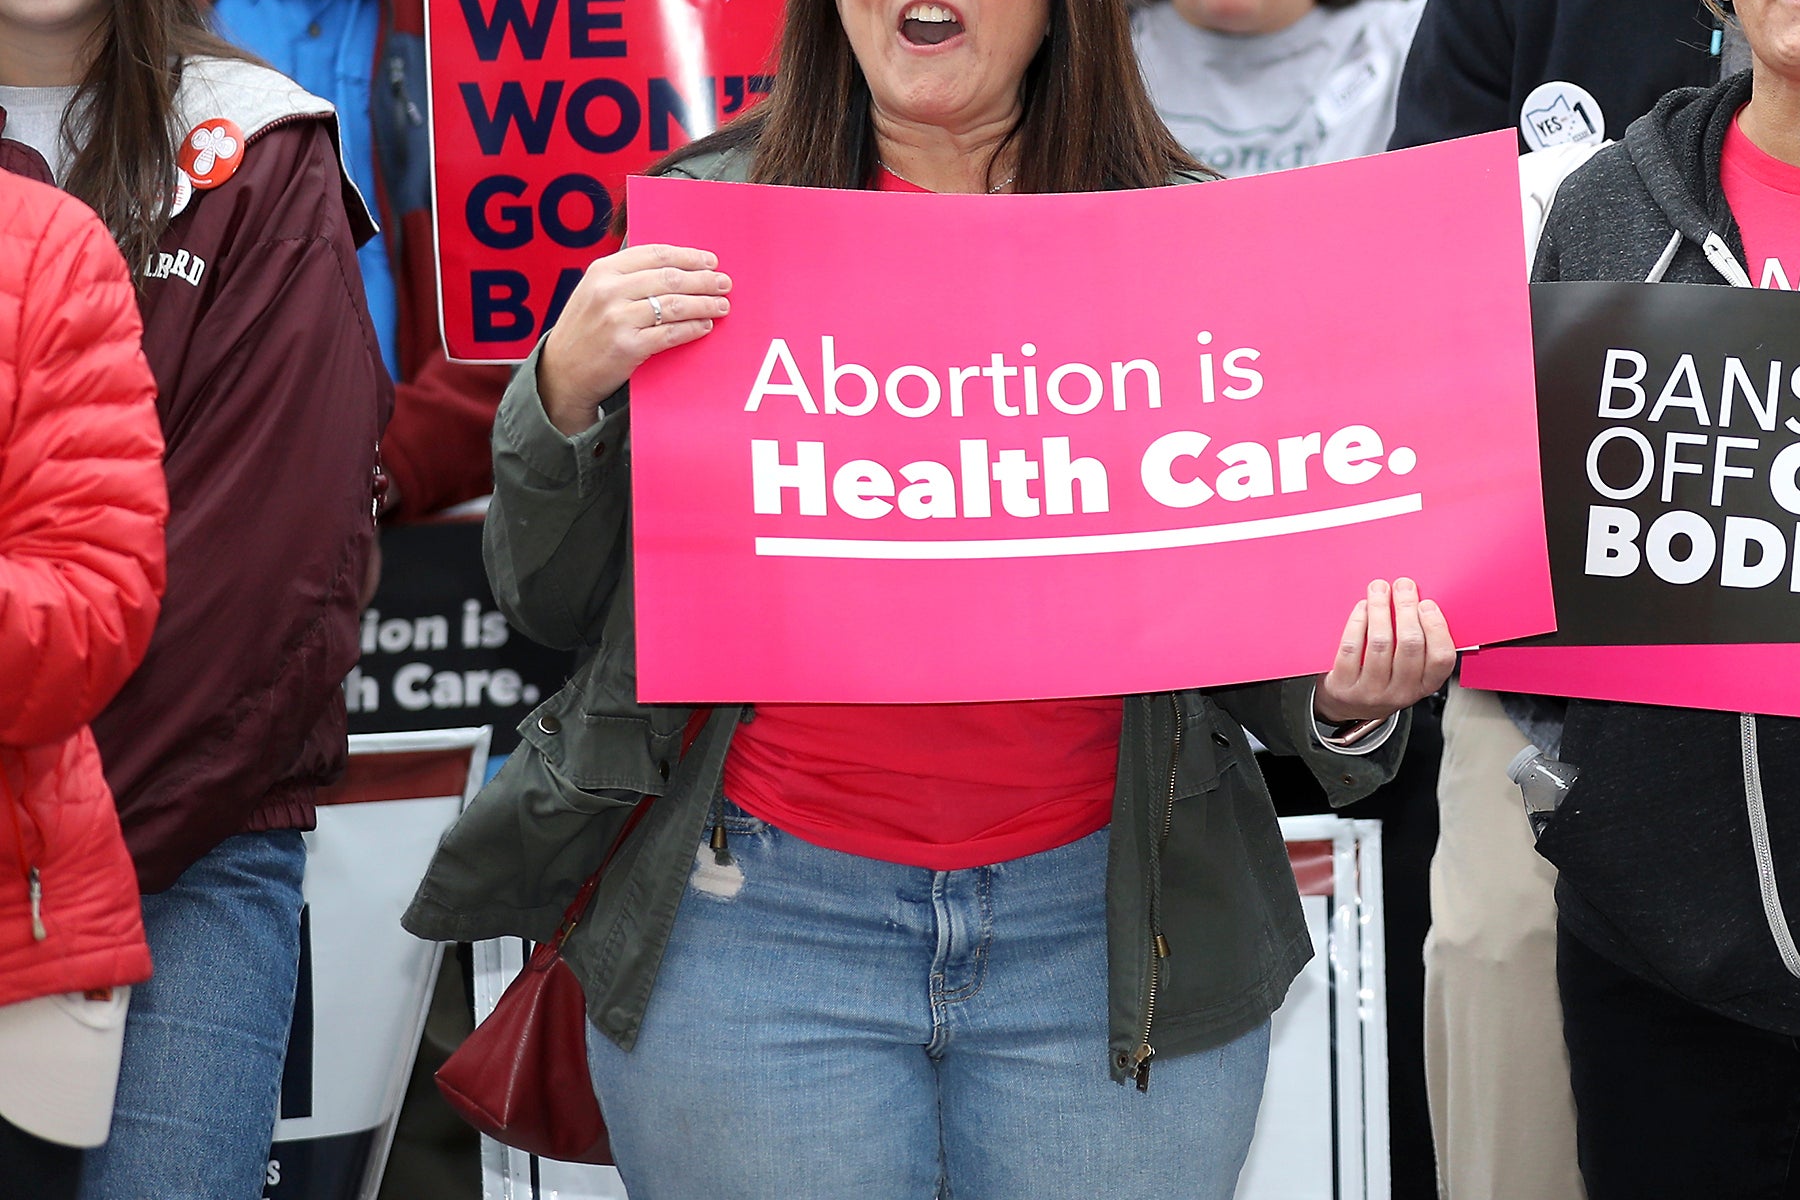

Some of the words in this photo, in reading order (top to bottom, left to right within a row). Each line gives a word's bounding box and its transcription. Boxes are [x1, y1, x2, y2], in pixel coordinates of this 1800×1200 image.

[1536, 115, 1563, 138] YES
[1573, 101, 1597, 135] 1
[465, 173, 613, 250] GO
[743, 334, 1162, 418] Abortion
[1197, 330, 1265, 404] is
[750, 436, 1111, 520] Health
[1140, 424, 1418, 509] Care.
[1585, 426, 1761, 508] OFF
[461, 597, 510, 649] is
[391, 660, 541, 712] Care.
